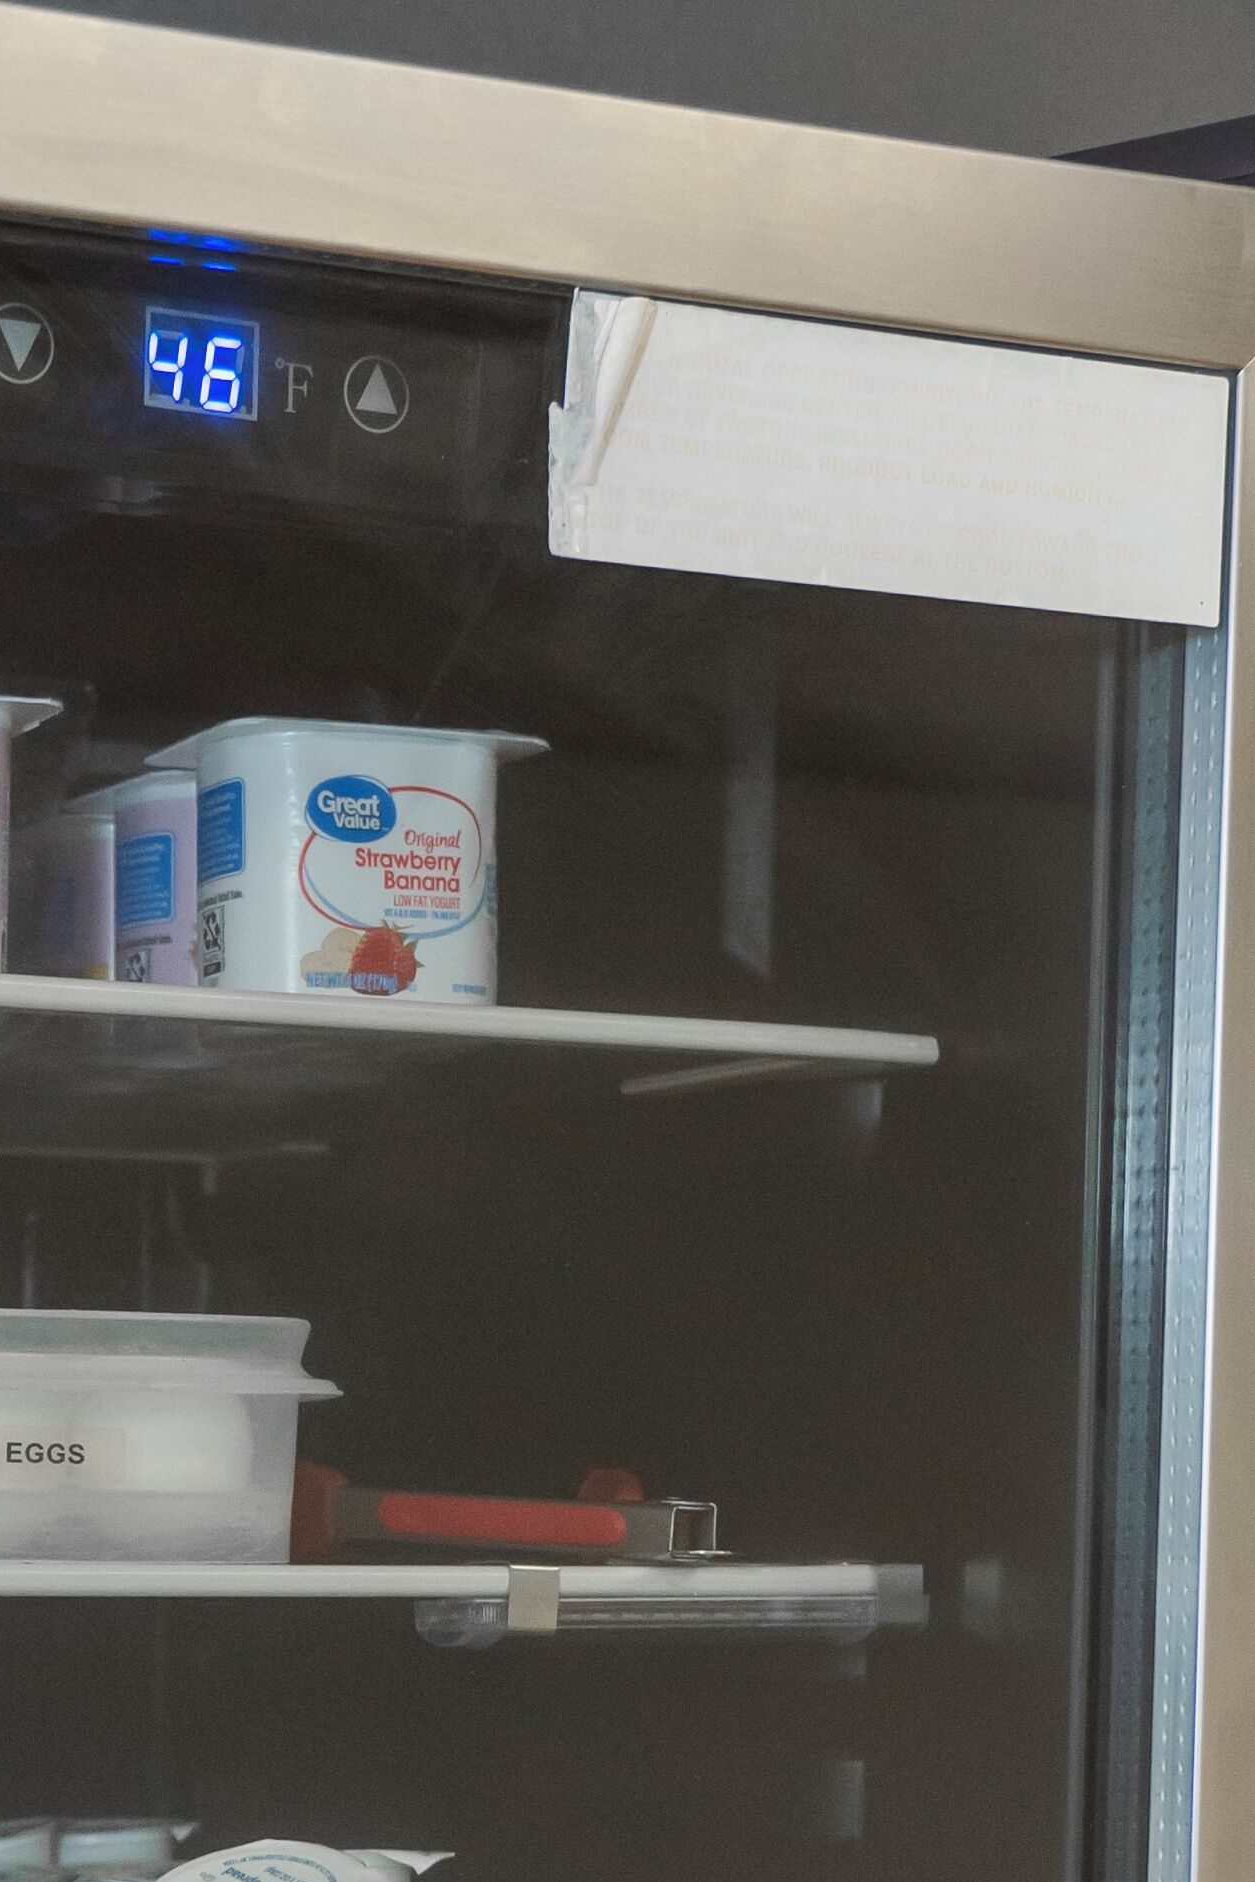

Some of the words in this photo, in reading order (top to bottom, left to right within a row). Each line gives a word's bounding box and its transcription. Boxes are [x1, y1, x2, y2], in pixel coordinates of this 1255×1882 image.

[147, 330, 243, 414] 46
[317, 789, 381, 817] Great
[334, 815, 381, 831] Value
[403, 829, 462, 853] Original
[354, 847, 462, 877] Strawberry
[383, 869, 461, 893] Banana
[393, 895, 413, 908] LOW
[413, 896, 428, 908] FAT
[429, 896, 461, 910] YOGURT
[5, 1441, 86, 1466] EGGS
